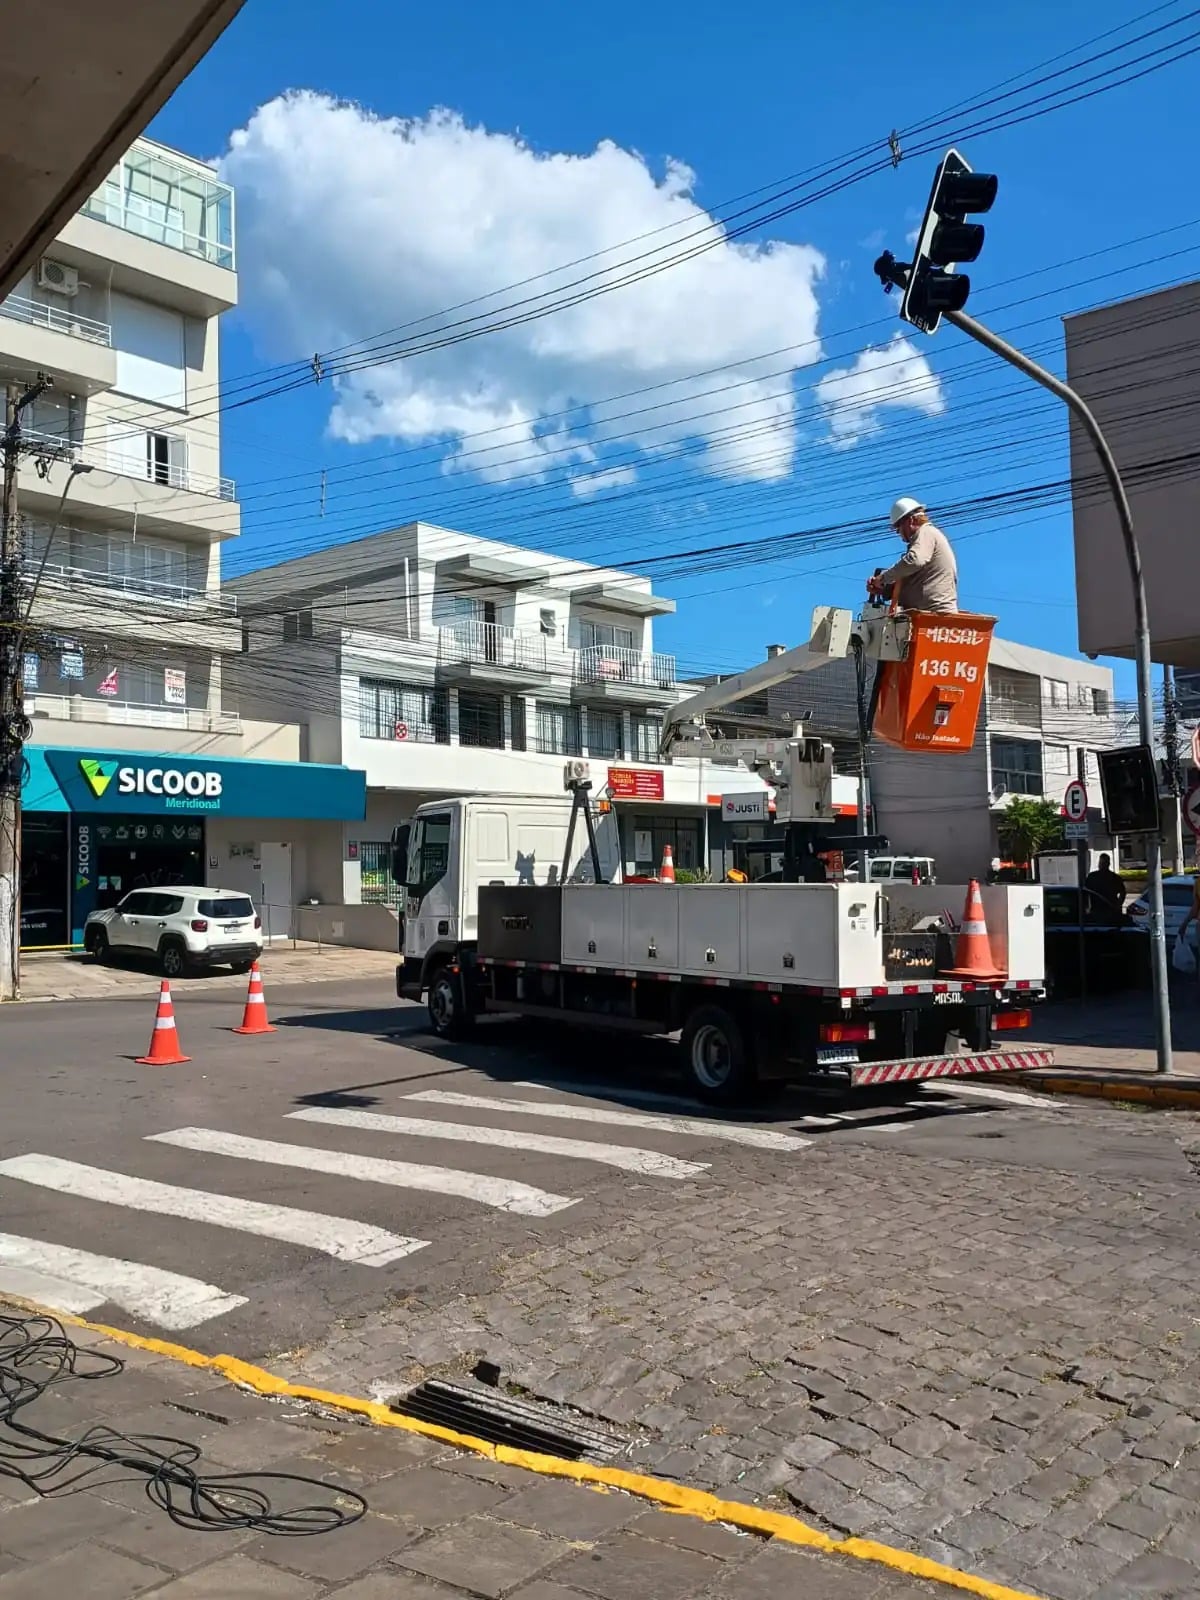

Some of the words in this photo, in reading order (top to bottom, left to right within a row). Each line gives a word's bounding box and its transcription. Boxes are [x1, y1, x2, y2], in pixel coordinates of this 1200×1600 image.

[919, 659, 949, 677] 136
[954, 661, 978, 682] Kg
[119, 767, 223, 797] SICOOB
[165, 797, 221, 809] Meridional
[1071, 789, 1081, 814] E
[78, 825, 89, 874] SICOOB
